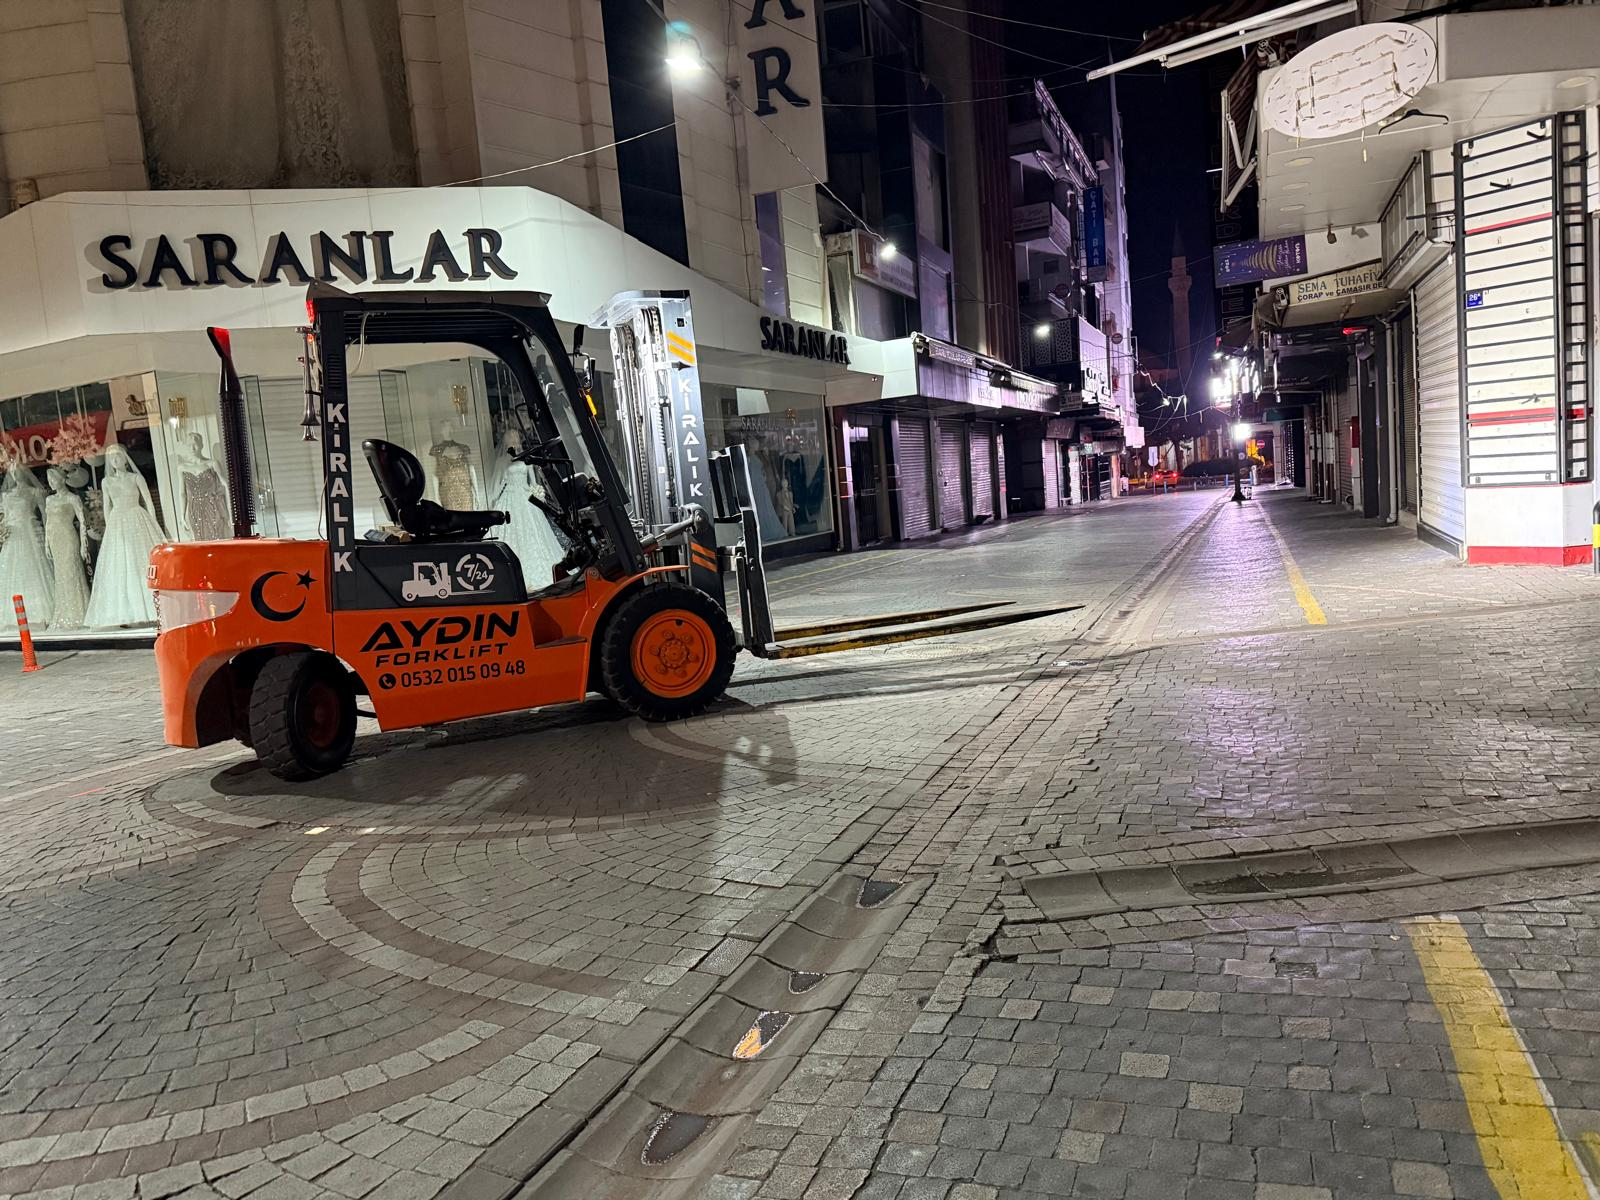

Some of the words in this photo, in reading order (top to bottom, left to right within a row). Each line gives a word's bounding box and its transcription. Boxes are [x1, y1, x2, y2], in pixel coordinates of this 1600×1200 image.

[100, 228, 518, 289] SARANLAR
[1092, 238, 1100, 266] BAR
[1298, 280, 1327, 294] SEMA
[1334, 269, 1382, 288] TUHAFİY
[1297, 292, 1324, 302] ÇORAP
[760, 316, 851, 365] SARANLAR
[678, 378, 703, 498] KİRALIK
[463, 563, 489, 582] 7/24
[360, 610, 520, 653] AYDIN
[401, 669, 444, 688] 0532
[447, 664, 476, 683] 015
[480, 662, 501, 679] 09
[505, 659, 526, 676] 48
